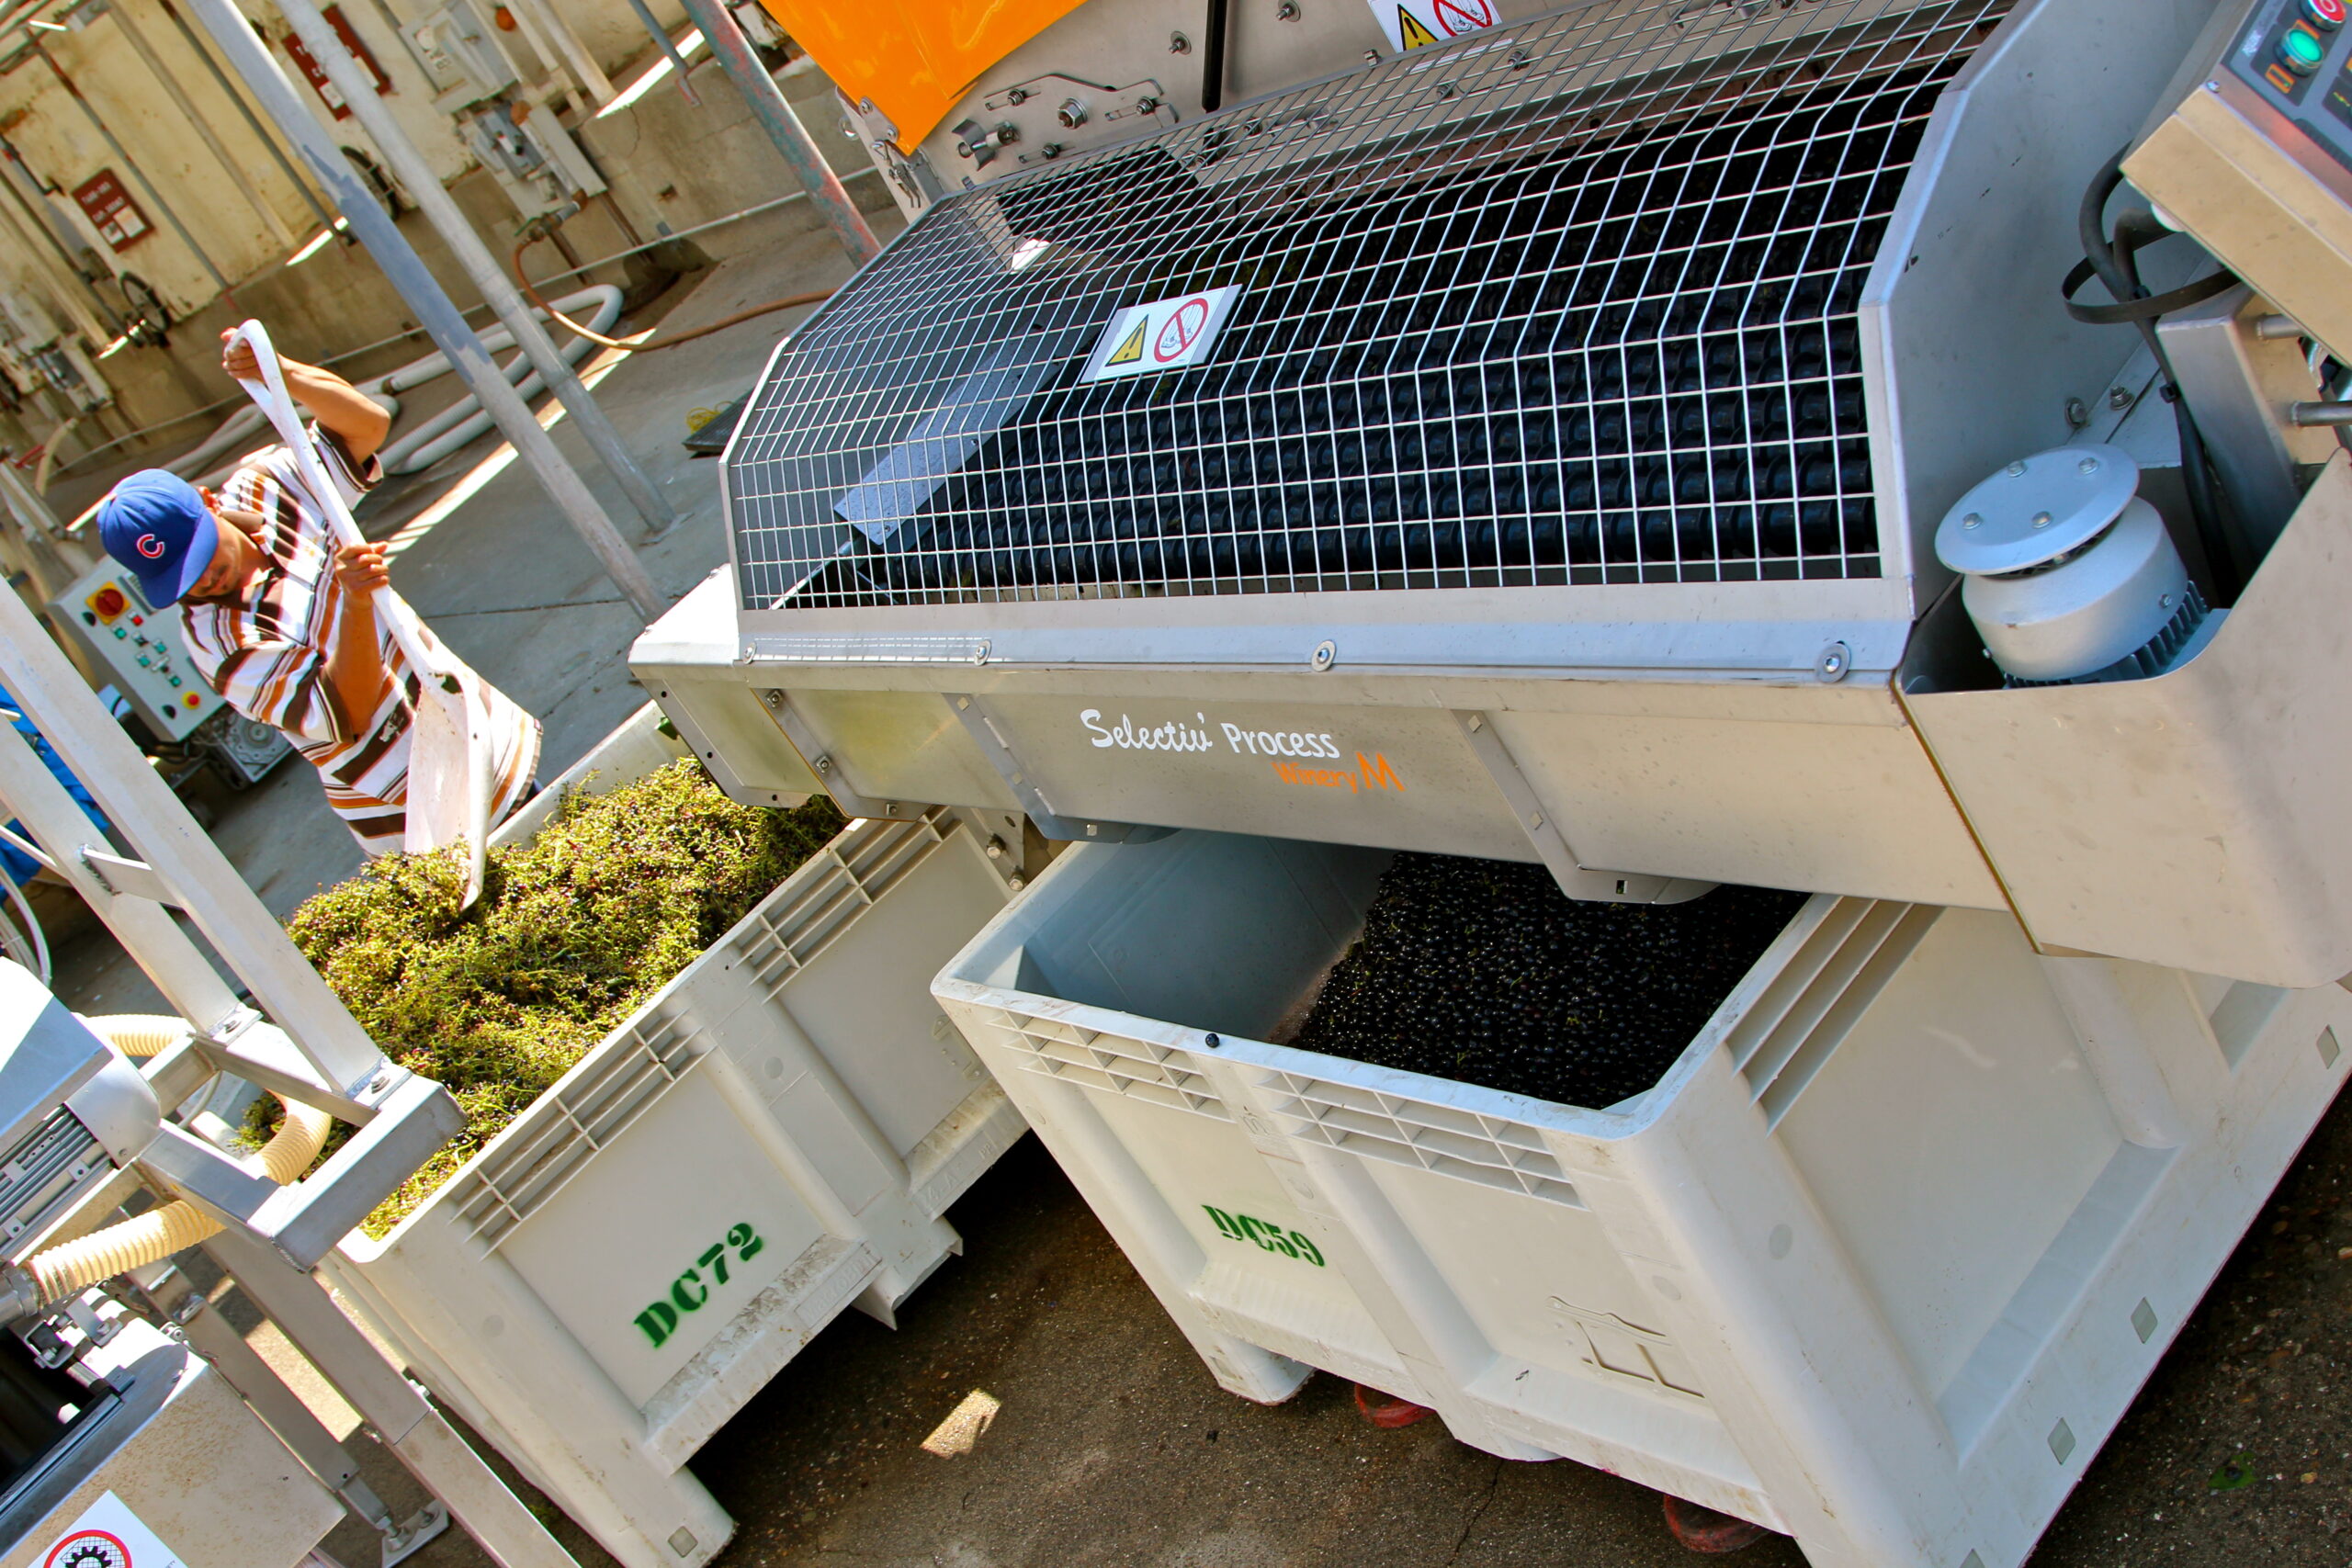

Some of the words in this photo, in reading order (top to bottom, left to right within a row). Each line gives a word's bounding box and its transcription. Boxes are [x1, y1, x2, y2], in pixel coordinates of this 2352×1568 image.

[136, 534, 164, 558] C
[1220, 721, 1340, 759] Process
[1270, 761, 1358, 794] Winery
[1355, 751, 1406, 792] M
[1201, 1204, 1325, 1267] DC59
[633, 1223, 763, 1349] DC72
